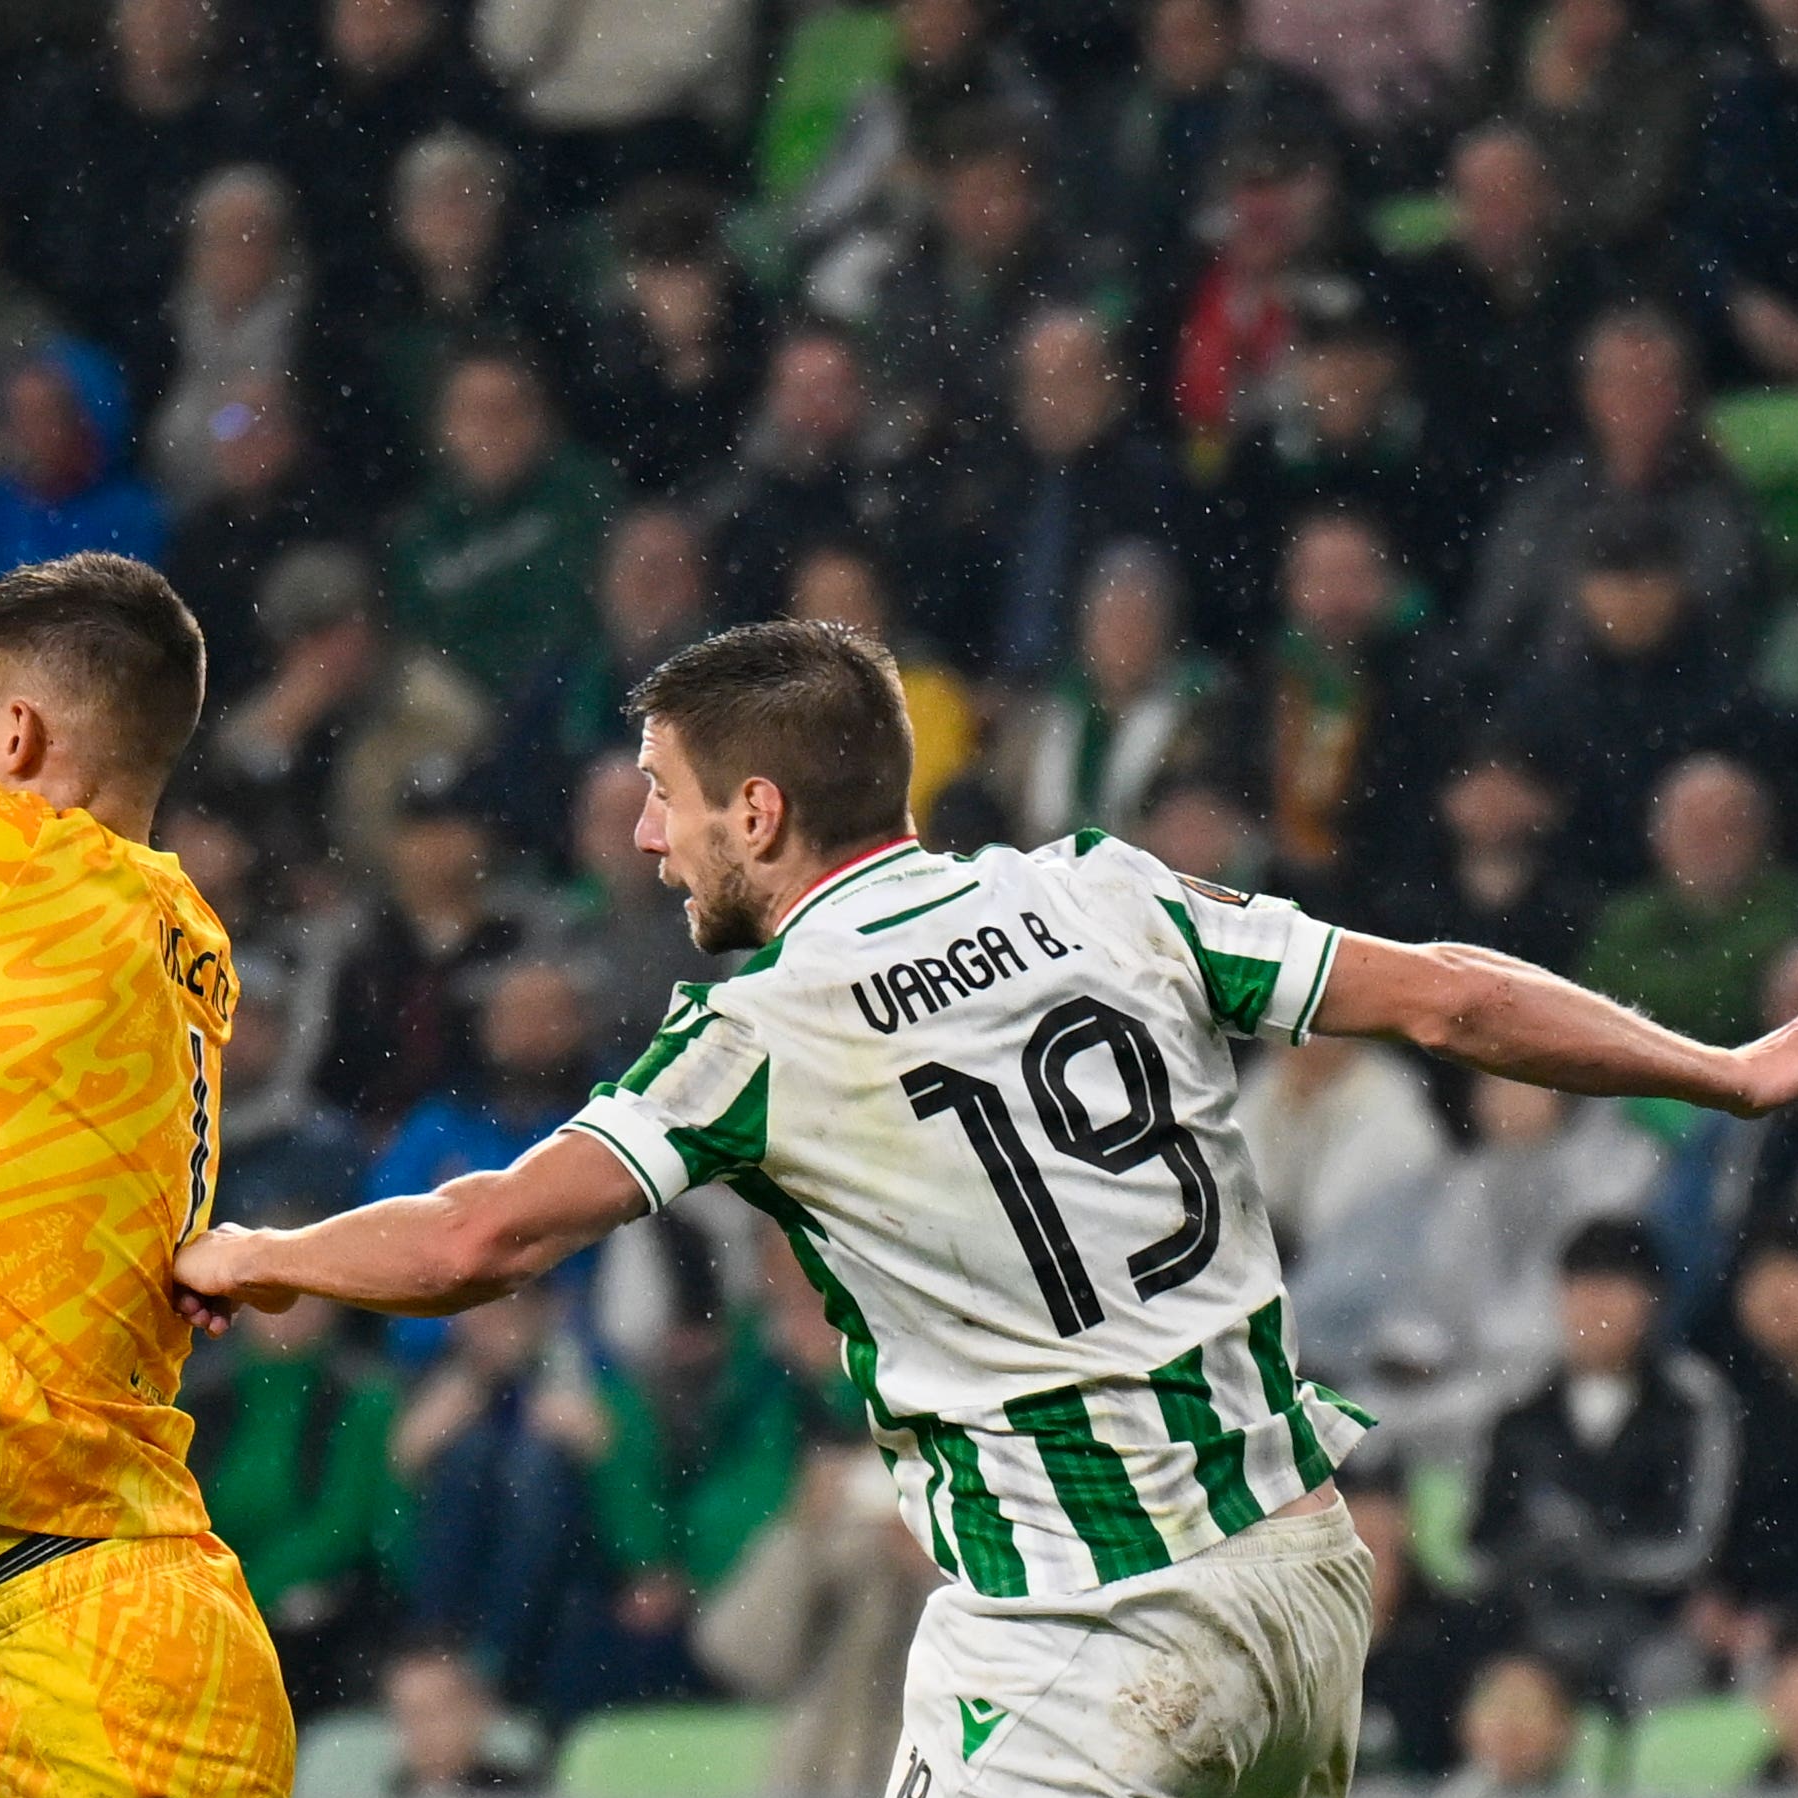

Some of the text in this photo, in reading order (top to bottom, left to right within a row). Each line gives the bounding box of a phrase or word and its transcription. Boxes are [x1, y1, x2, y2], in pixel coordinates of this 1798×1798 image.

[851, 912, 1081, 1034] VARGA B.
[900, 996, 1220, 1338] 19
